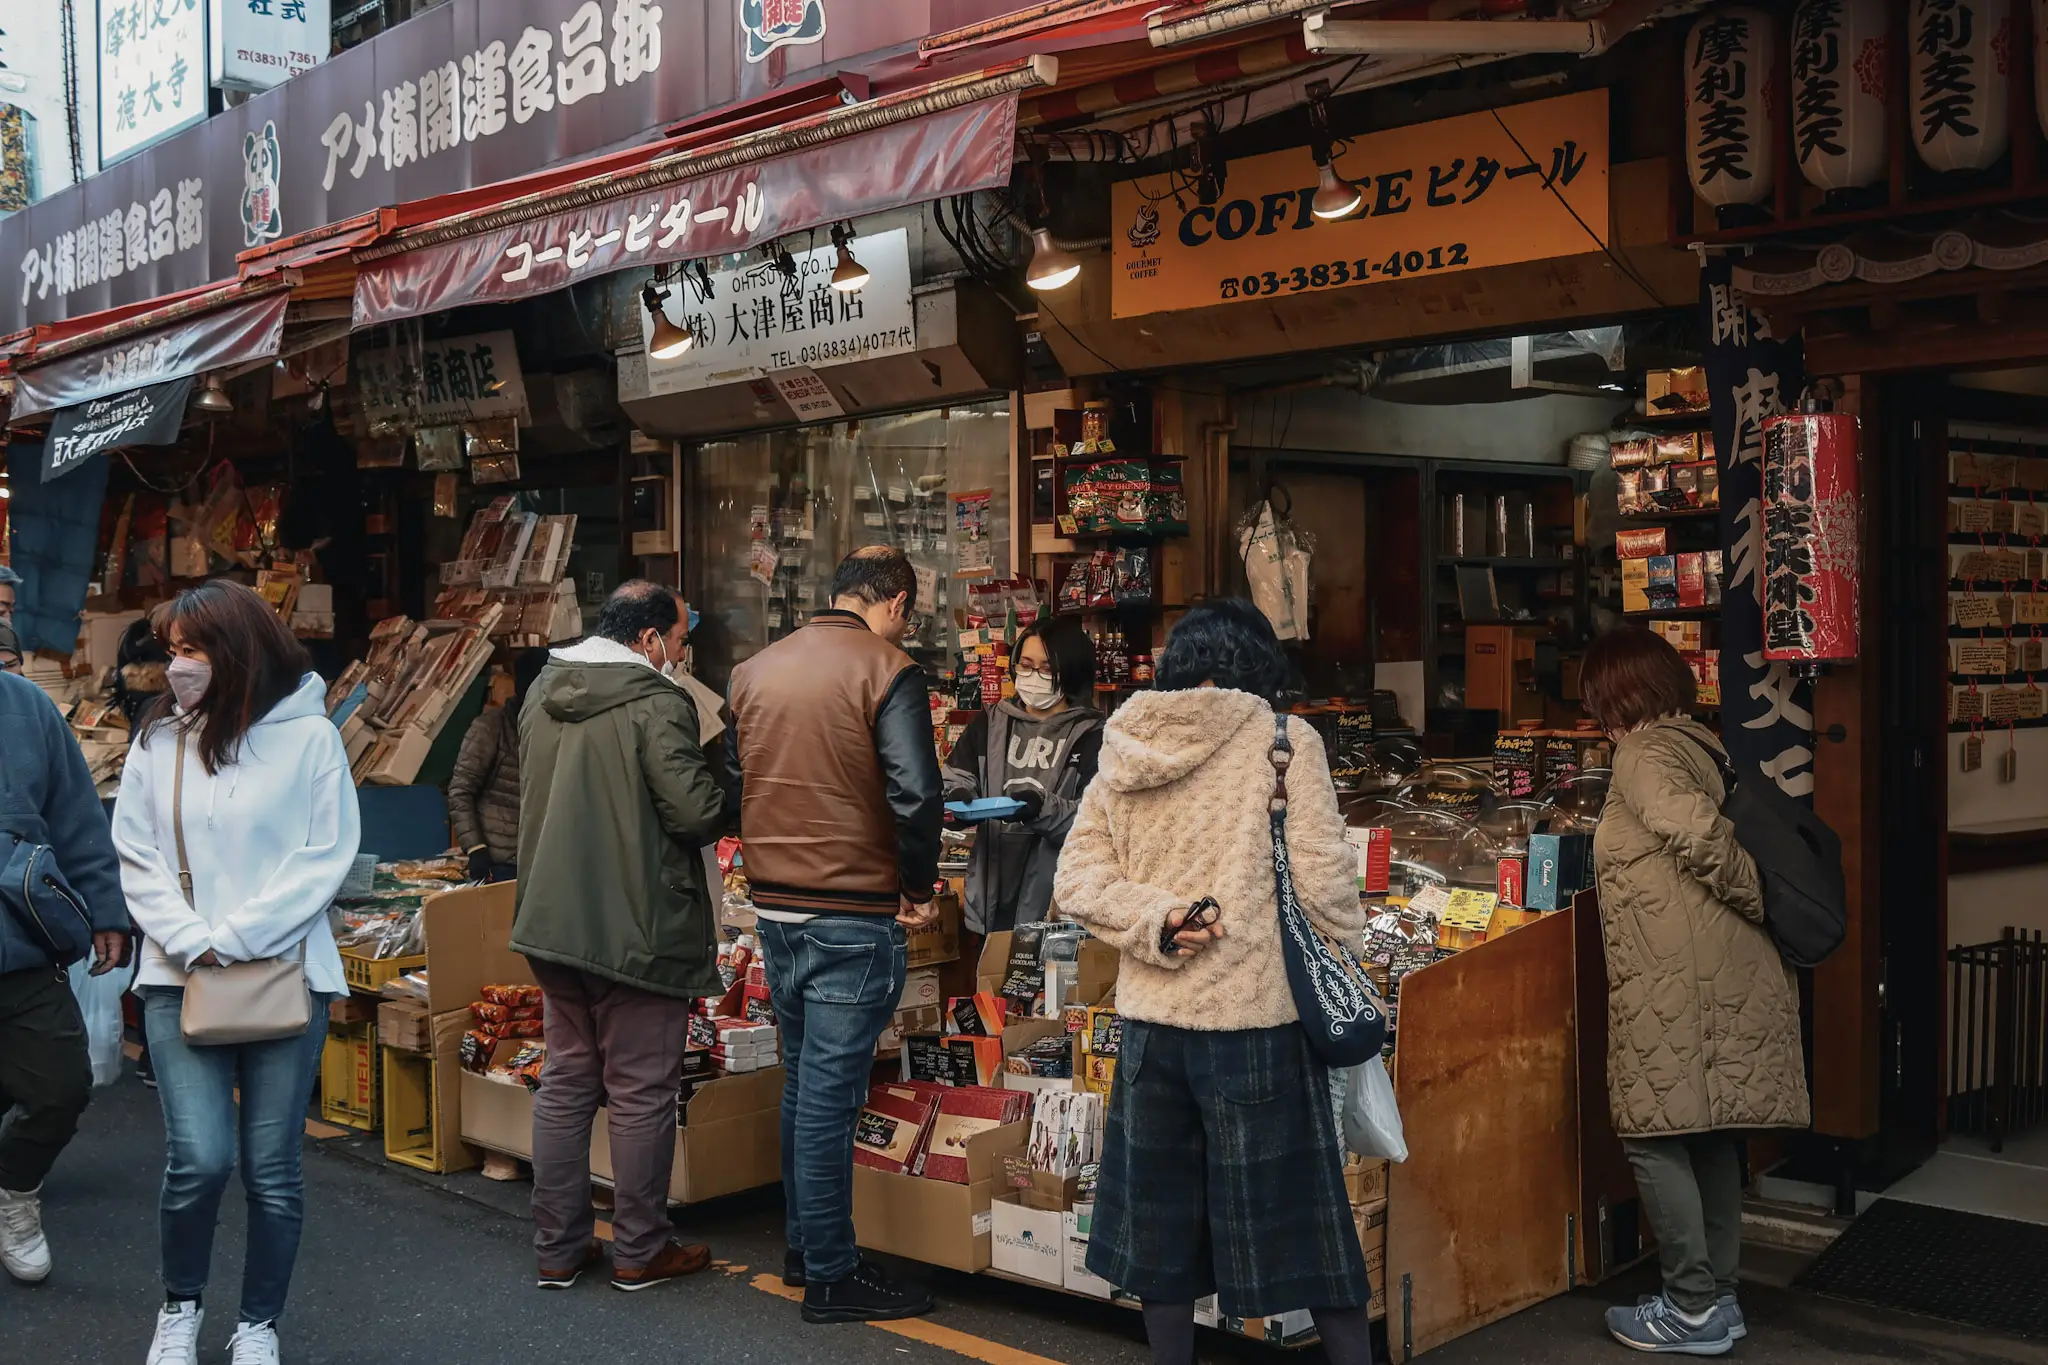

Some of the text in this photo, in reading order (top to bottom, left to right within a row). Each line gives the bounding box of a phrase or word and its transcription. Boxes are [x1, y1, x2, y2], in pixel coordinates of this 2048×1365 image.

[289, 51, 317, 65] 7361
[1693, 16, 1752, 185] 摩利支天
[1427, 140, 1588, 207] ビタール
[501, 182, 765, 283] コーヒービタール
[1126, 257, 1163, 270] GOURMET
[1129, 267, 1160, 280] COFFEE
[1242, 242, 1469, 297] 03-3831-4012
[357, 1044, 369, 1104] MEIJI
